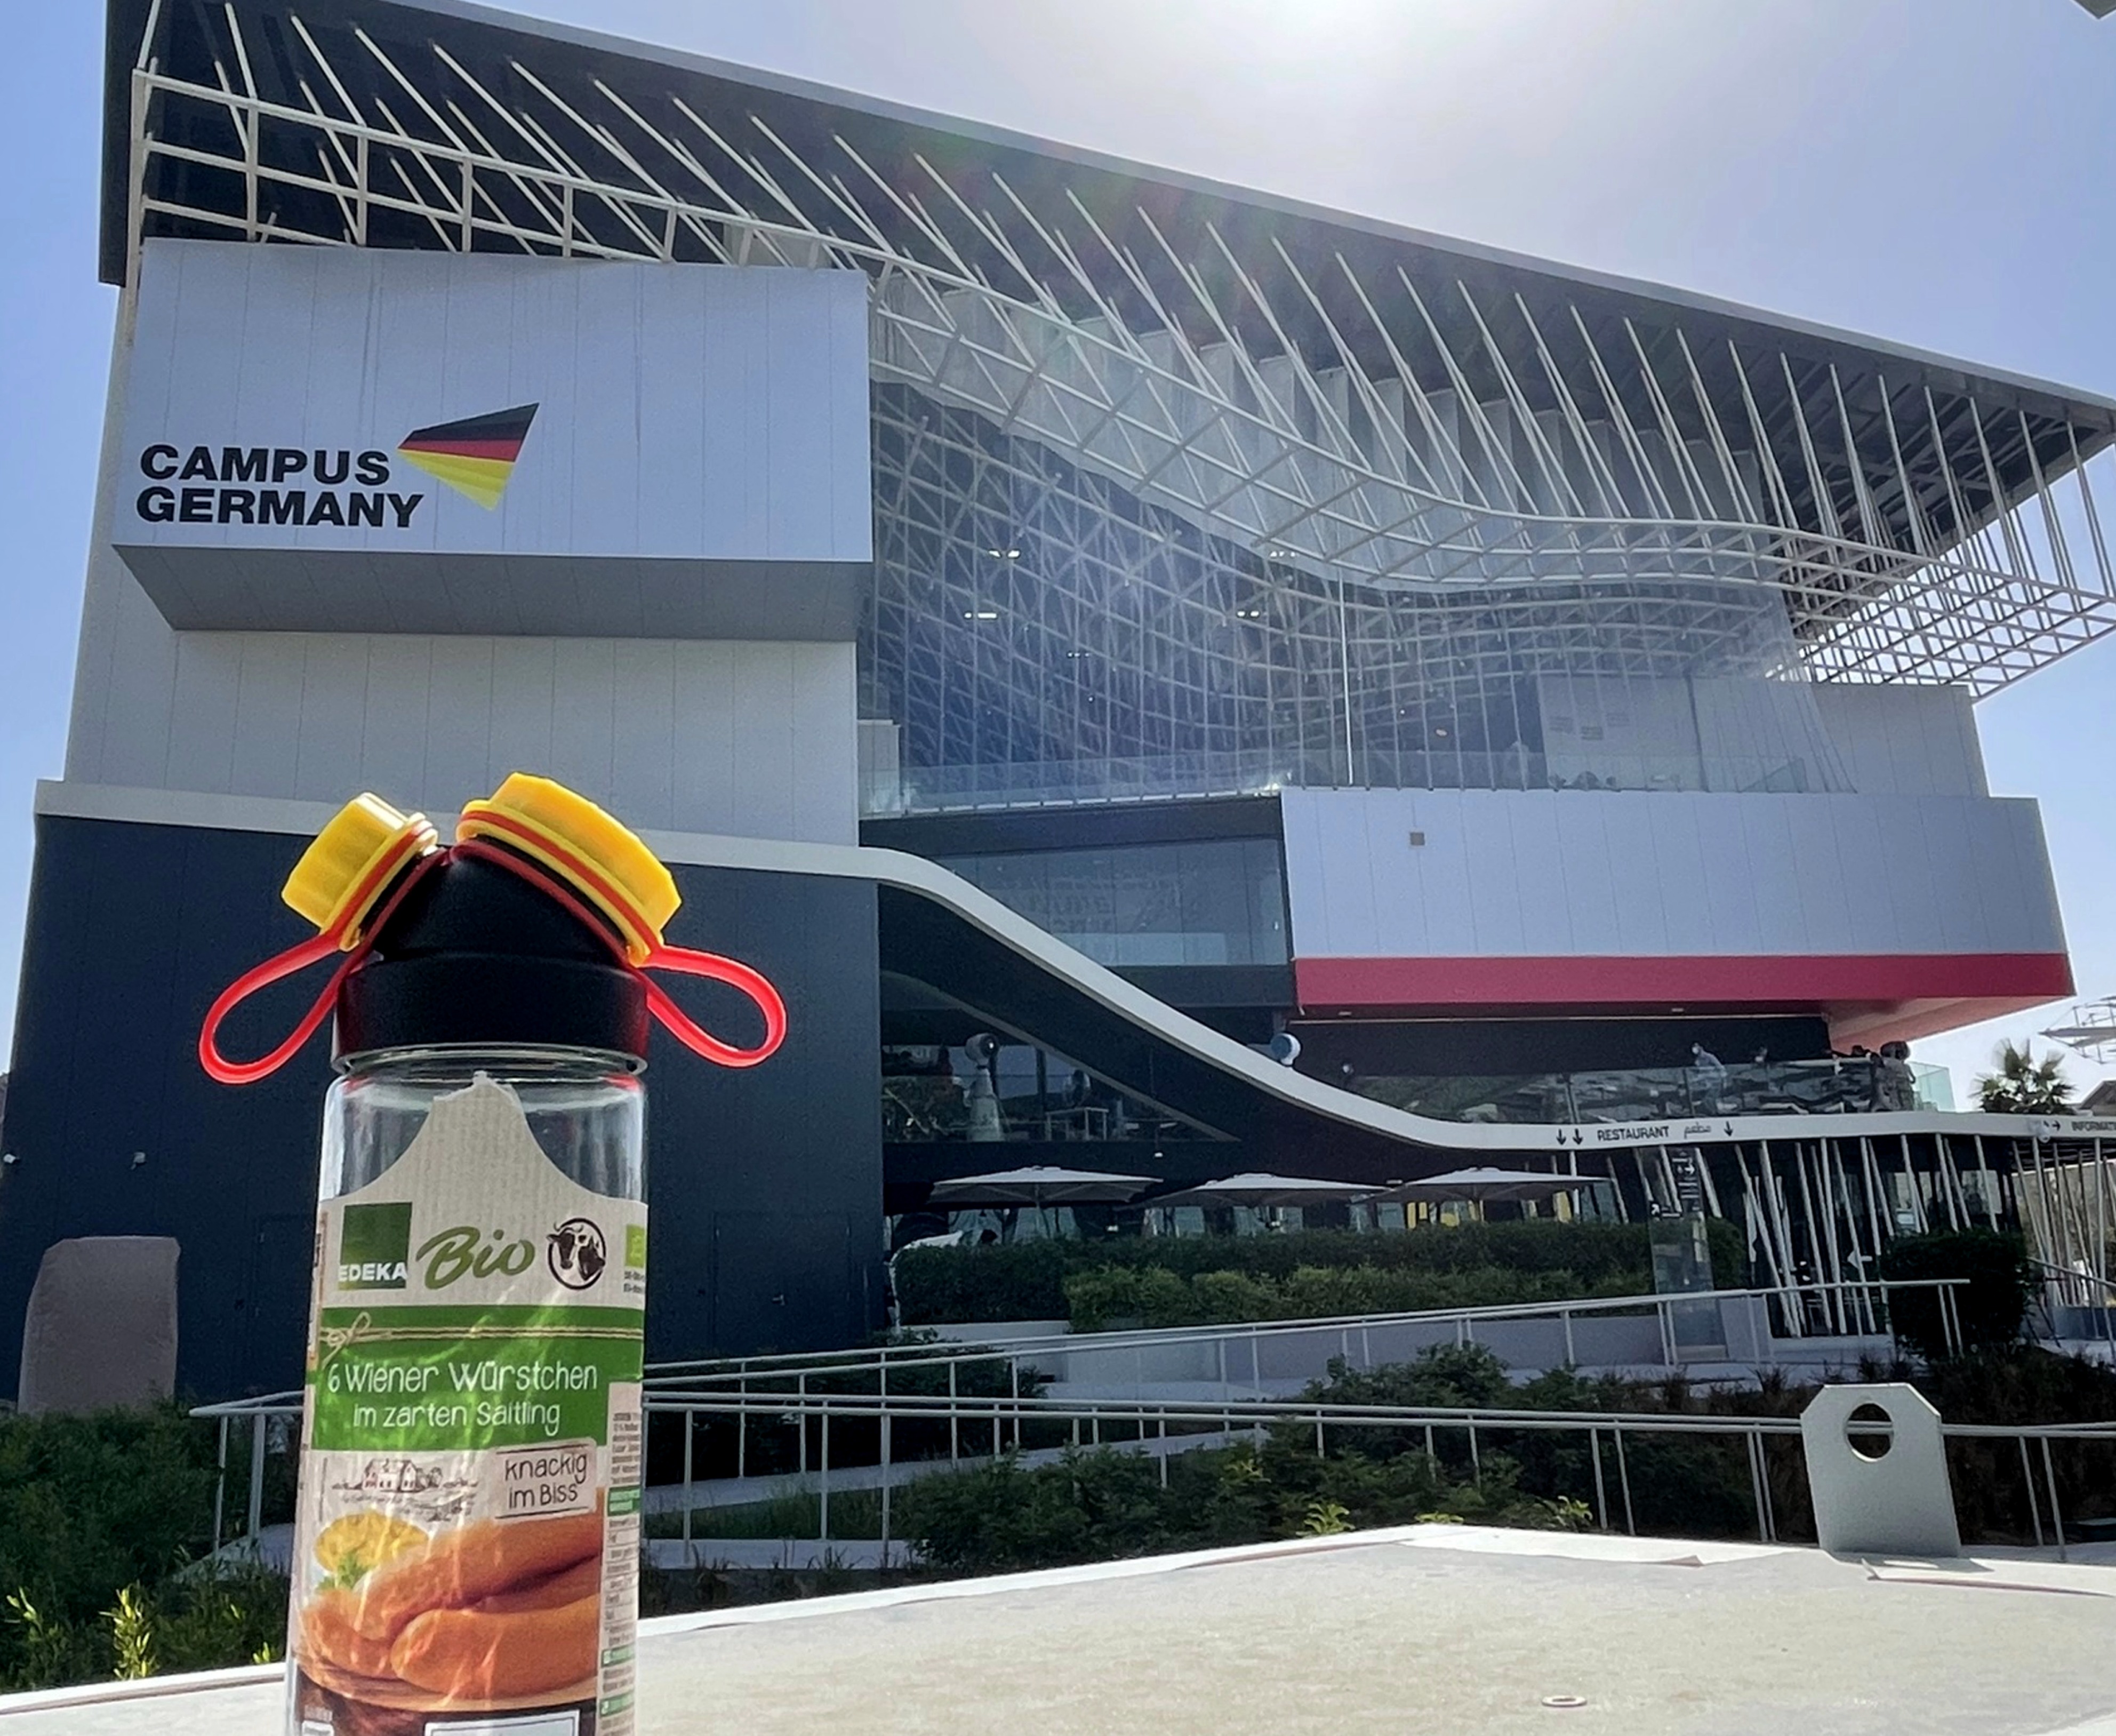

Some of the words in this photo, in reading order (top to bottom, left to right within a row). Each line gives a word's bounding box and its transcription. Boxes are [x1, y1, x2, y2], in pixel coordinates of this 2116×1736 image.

[141, 444, 390, 486] CAMPUS
[137, 486, 424, 528] GERMANY
[1597, 1126, 1669, 1141] RESTAURANT
[1684, 1121, 1711, 1139] مطعم
[338, 1262, 409, 1282] EDEKA
[415, 1226, 535, 1290] Bio
[327, 1363, 340, 1393] 6
[345, 1362, 439, 1393] Wiener
[448, 1361, 597, 1392] Würstchen
[353, 1403, 376, 1427] im
[382, 1403, 467, 1427] zarten
[504, 1453, 587, 1484] knackig
[509, 1486, 535, 1509] im
[540, 1482, 578, 1506] Biss
